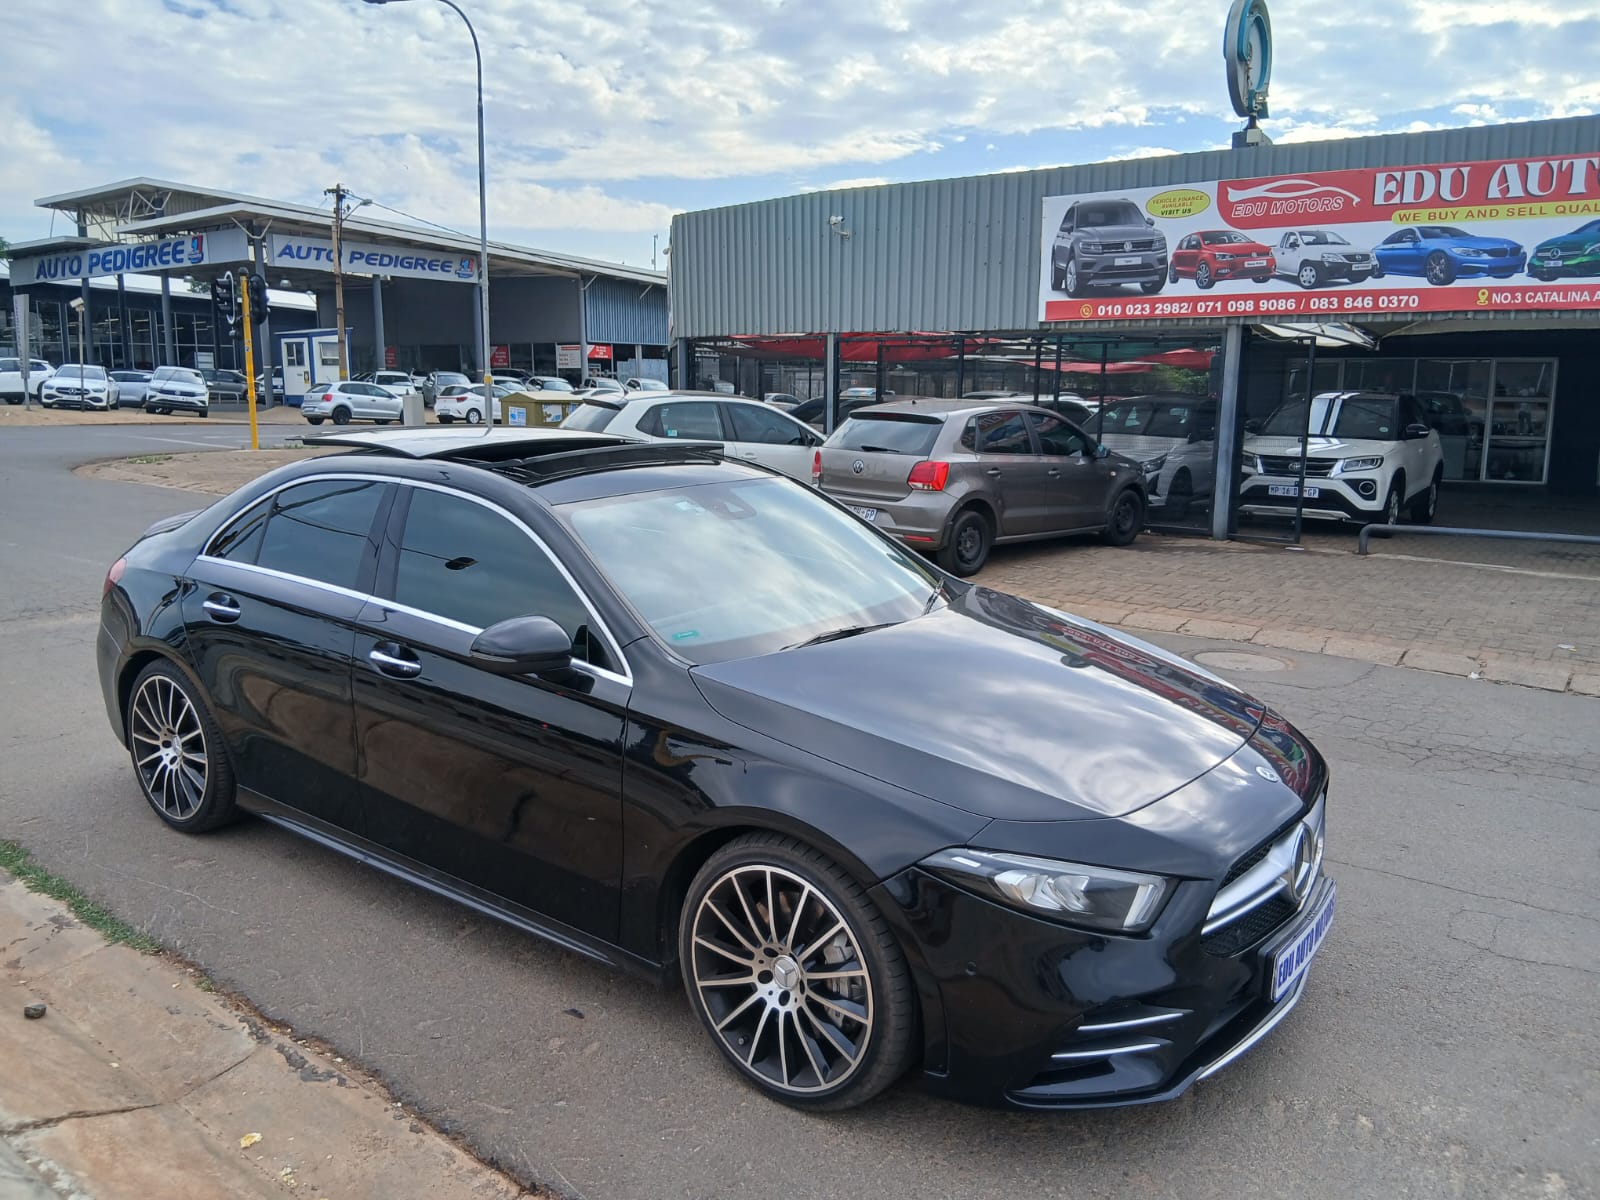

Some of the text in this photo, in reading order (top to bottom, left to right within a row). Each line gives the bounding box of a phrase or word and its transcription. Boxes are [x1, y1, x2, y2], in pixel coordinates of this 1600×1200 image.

[1374, 157, 1600, 206] EDU AUT
[1231, 196, 1344, 217] EDU MOTORS
[1399, 212, 1421, 222] WE
[1427, 210, 1459, 221] BUY
[1465, 208, 1499, 219] AND
[1506, 205, 1548, 217] SELL
[36, 240, 186, 280] AUTO PEDIGREE
[349, 250, 453, 273] PEDIGREE
[1097, 304, 1122, 316] 010
[1125, 303, 1150, 315] 023
[1196, 301, 1222, 313] 071
[1227, 300, 1254, 312] 098
[1259, 298, 1296, 311] 9086
[1309, 297, 1338, 309] 083
[1343, 296, 1373, 308] 846
[1378, 295, 1419, 308] 0370
[1491, 292, 1522, 304] NO.3
[1525, 290, 1591, 303] CATALINA
[1278, 949, 1295, 988] EDU
